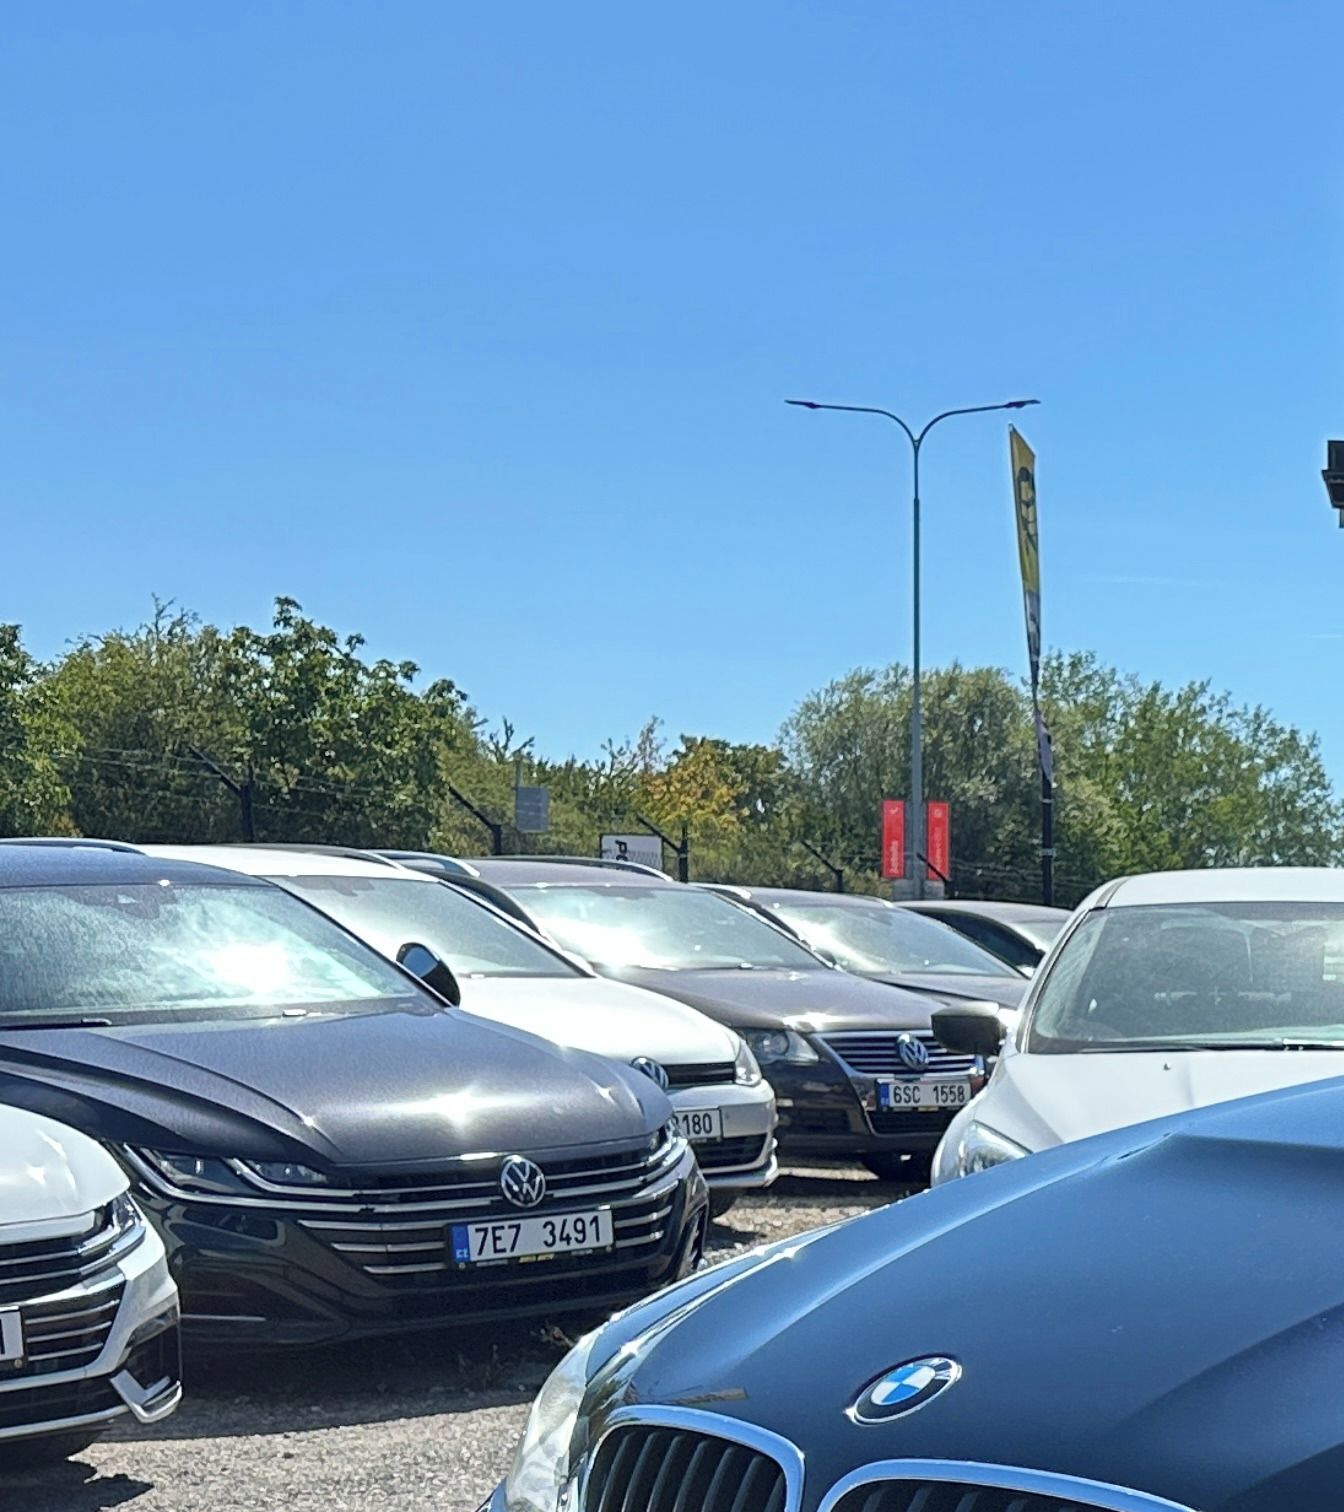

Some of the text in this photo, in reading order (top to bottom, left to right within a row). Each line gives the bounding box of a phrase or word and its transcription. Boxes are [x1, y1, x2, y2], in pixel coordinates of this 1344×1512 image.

[893, 1085, 966, 1103] 6SC 1558
[475, 1223, 521, 1256] 7E7
[542, 1215, 600, 1248] 3491
